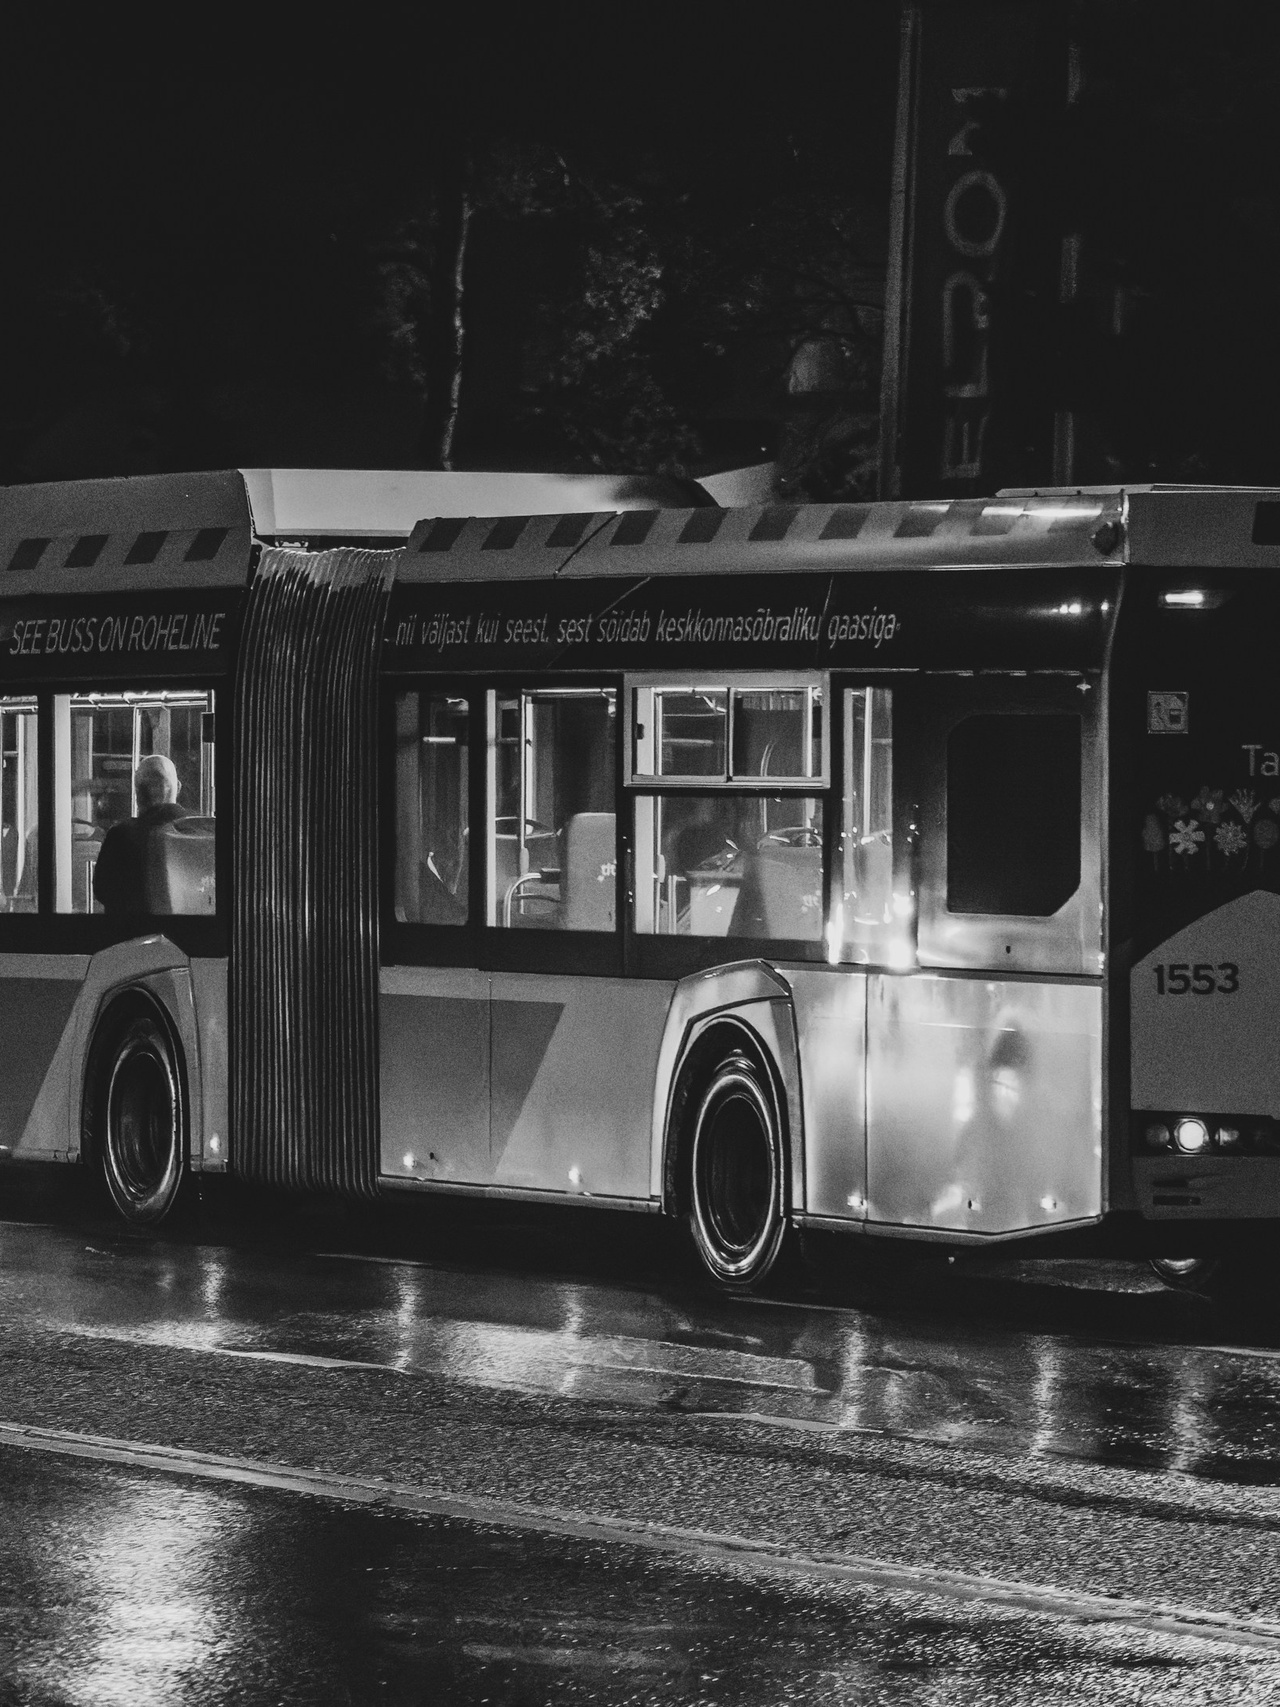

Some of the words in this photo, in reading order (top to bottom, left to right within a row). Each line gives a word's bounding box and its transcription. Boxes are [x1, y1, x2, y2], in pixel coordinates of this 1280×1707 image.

[9, 618, 47, 655] SEE
[45, 616, 98, 653] BUSS
[98, 615, 128, 652] ON
[128, 612, 226, 651] ROHELINE
[421, 613, 471, 653] väljast
[474, 611, 501, 644] kui
[556, 613, 595, 644] sest
[1153, 962, 1241, 996] 1553
